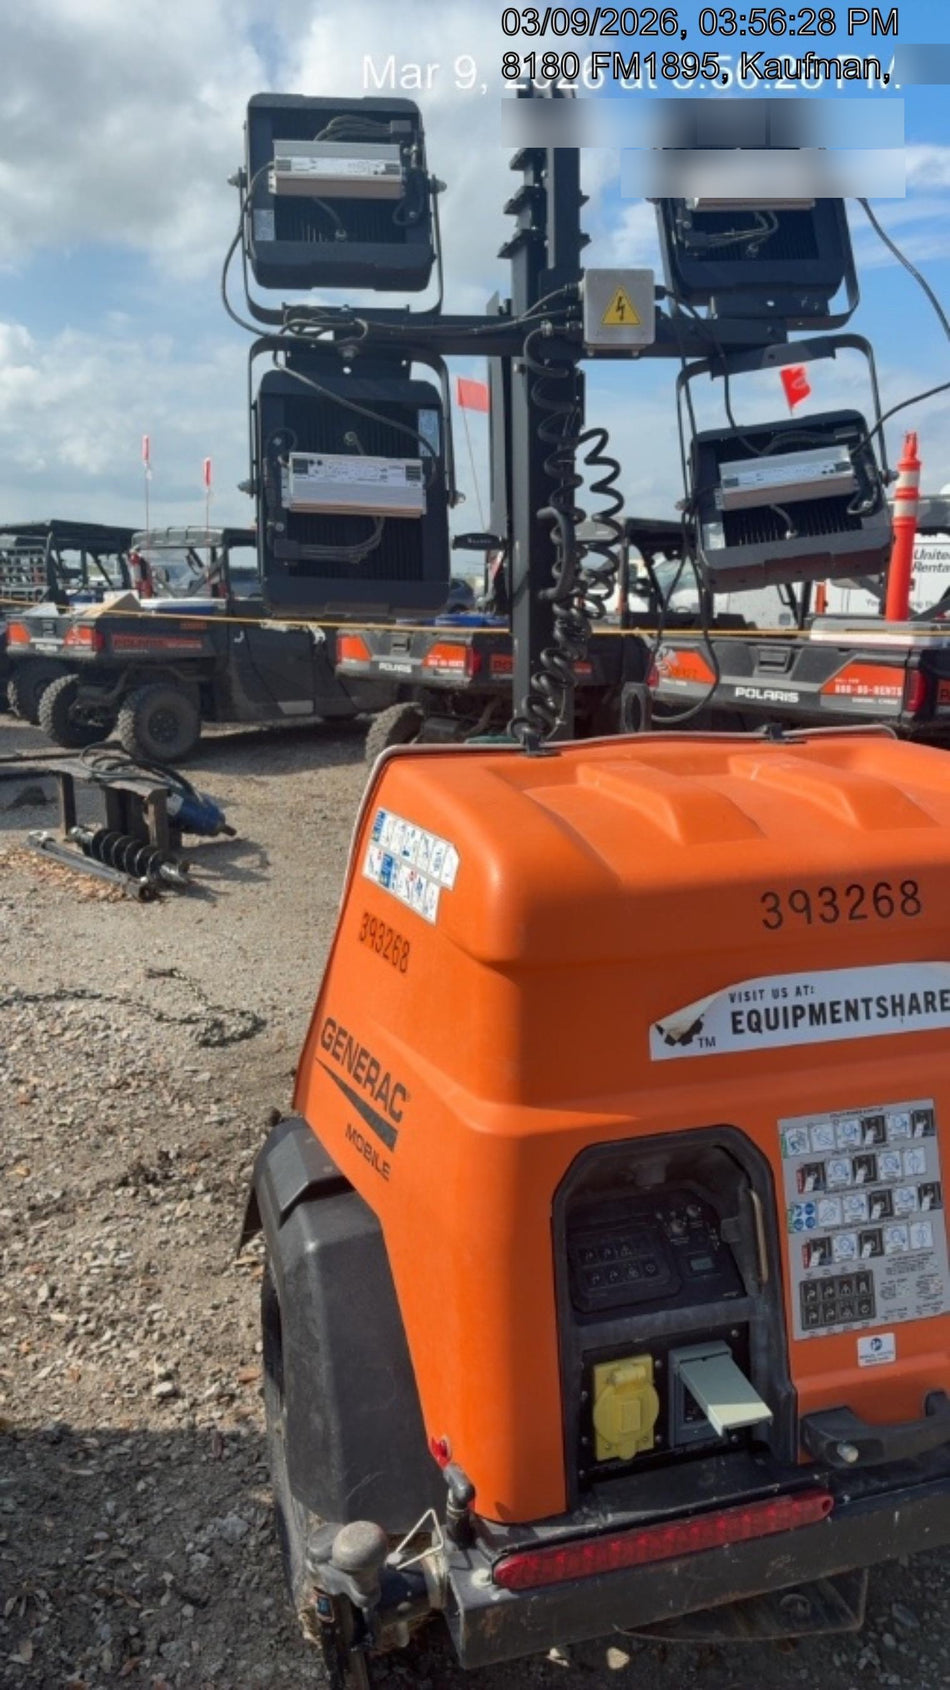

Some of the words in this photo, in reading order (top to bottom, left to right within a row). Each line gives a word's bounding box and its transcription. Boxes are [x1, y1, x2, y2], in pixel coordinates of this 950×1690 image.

[735, 686, 799, 703] POLARIS
[759, 879, 922, 930] 393268
[358, 911, 411, 974] 393268
[728, 989, 765, 1004] VISIT
[771, 986, 788, 1000] US
[795, 984, 815, 997] AT:
[730, 988, 950, 1035] EQUIPMENTSHARE
[320, 1017, 408, 1124] GENERAC
[345, 1123, 391, 1183] MOBILE
